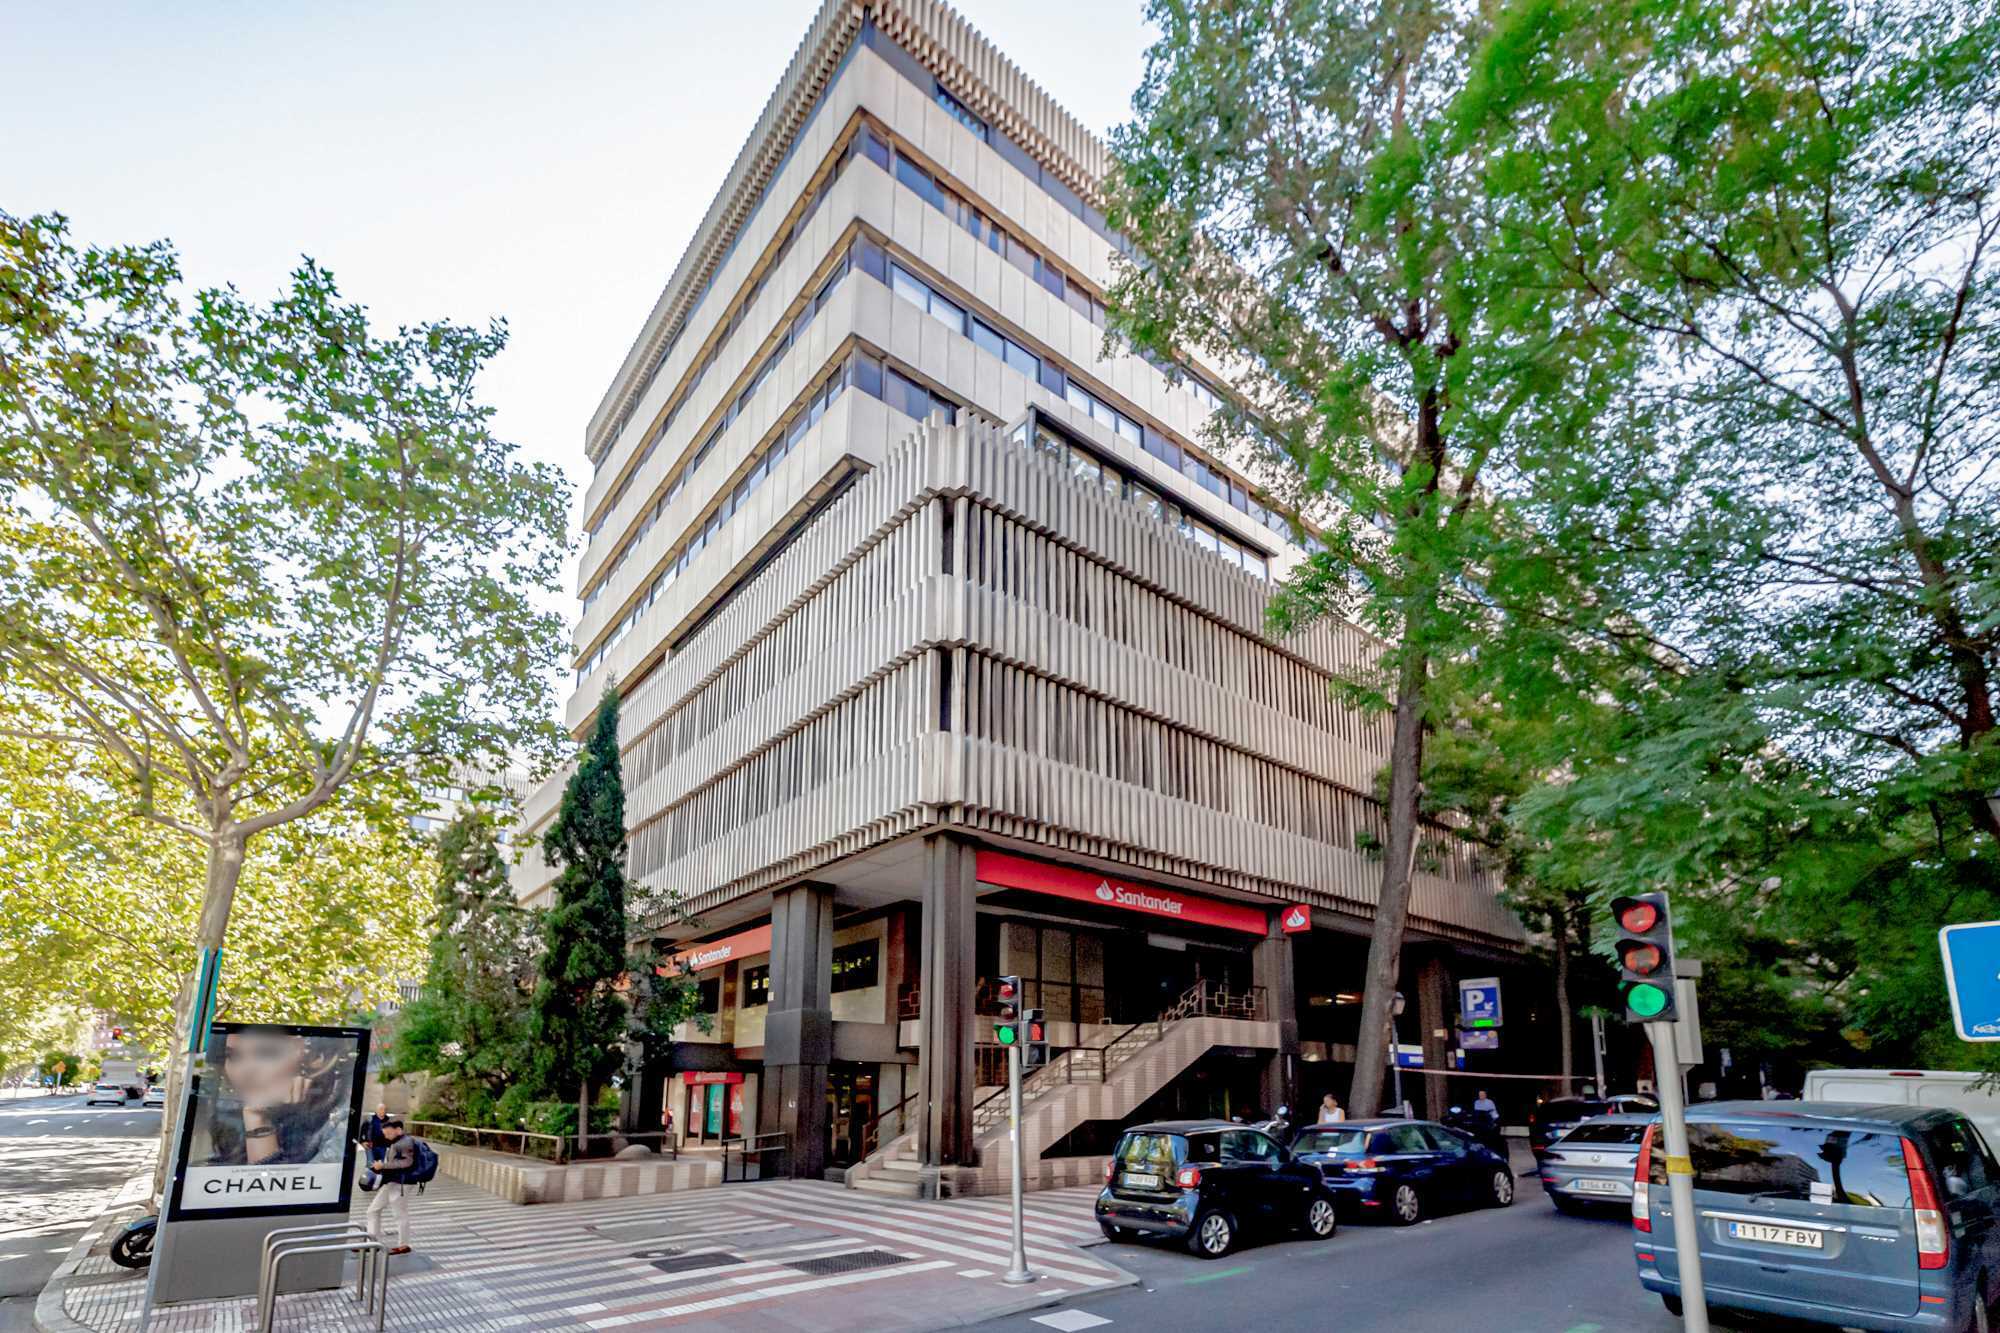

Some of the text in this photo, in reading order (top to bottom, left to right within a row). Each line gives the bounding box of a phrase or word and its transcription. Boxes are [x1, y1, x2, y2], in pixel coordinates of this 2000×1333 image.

[1115, 886, 1184, 915] Santander
[698, 945, 732, 962] Santander
[1466, 990, 1485, 1011] P
[203, 1175, 323, 1194] CHANEL
[1740, 1224, 1817, 1245] 1117 FBV
